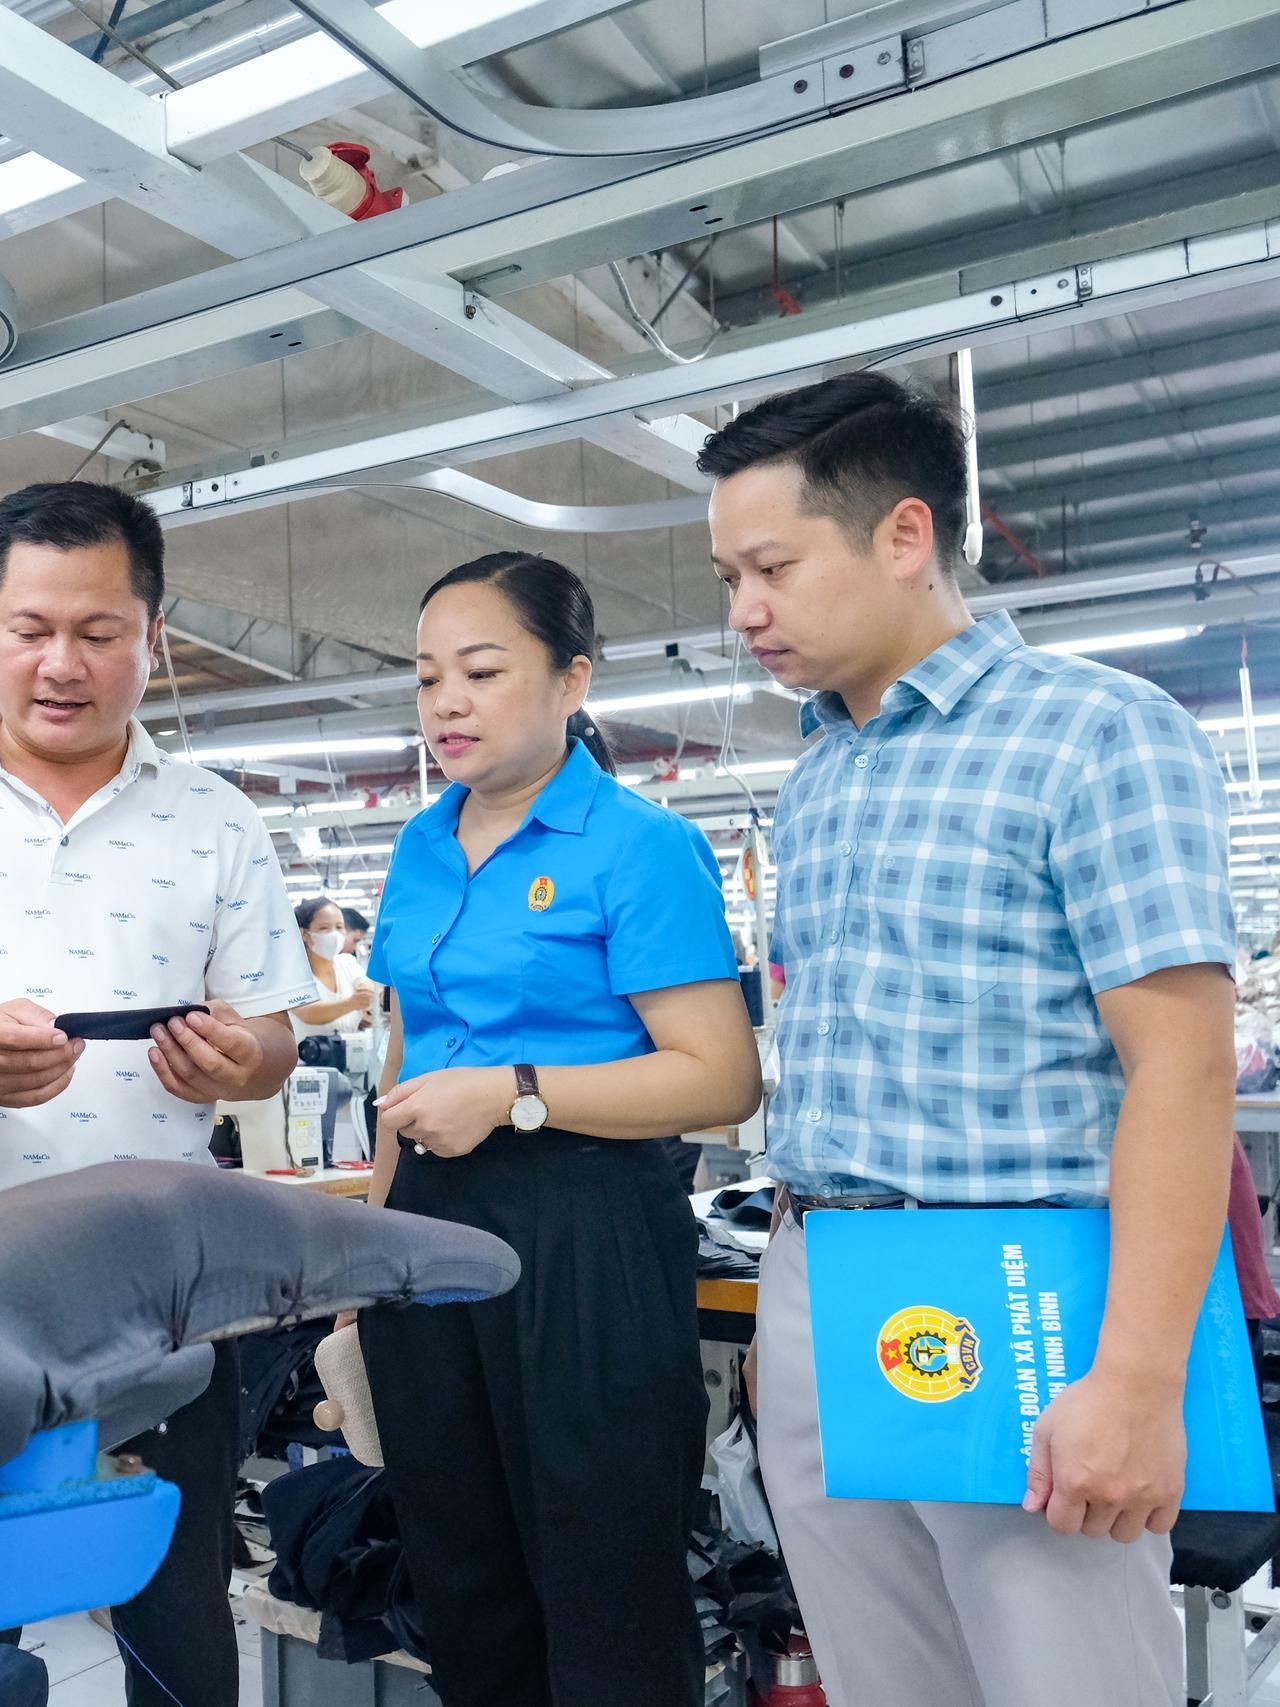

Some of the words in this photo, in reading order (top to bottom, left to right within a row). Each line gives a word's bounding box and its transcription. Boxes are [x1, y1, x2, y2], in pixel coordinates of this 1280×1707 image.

[1000, 1244, 1028, 1287] DIỆM
[1005, 1292, 1032, 1336] PHÁT
[1037, 1292, 1062, 1331] BÌNH
[1010, 1340, 1035, 1364] XÃ
[1043, 1336, 1067, 1378] NINH
[1014, 1368, 1040, 1416] ĐOÀN
